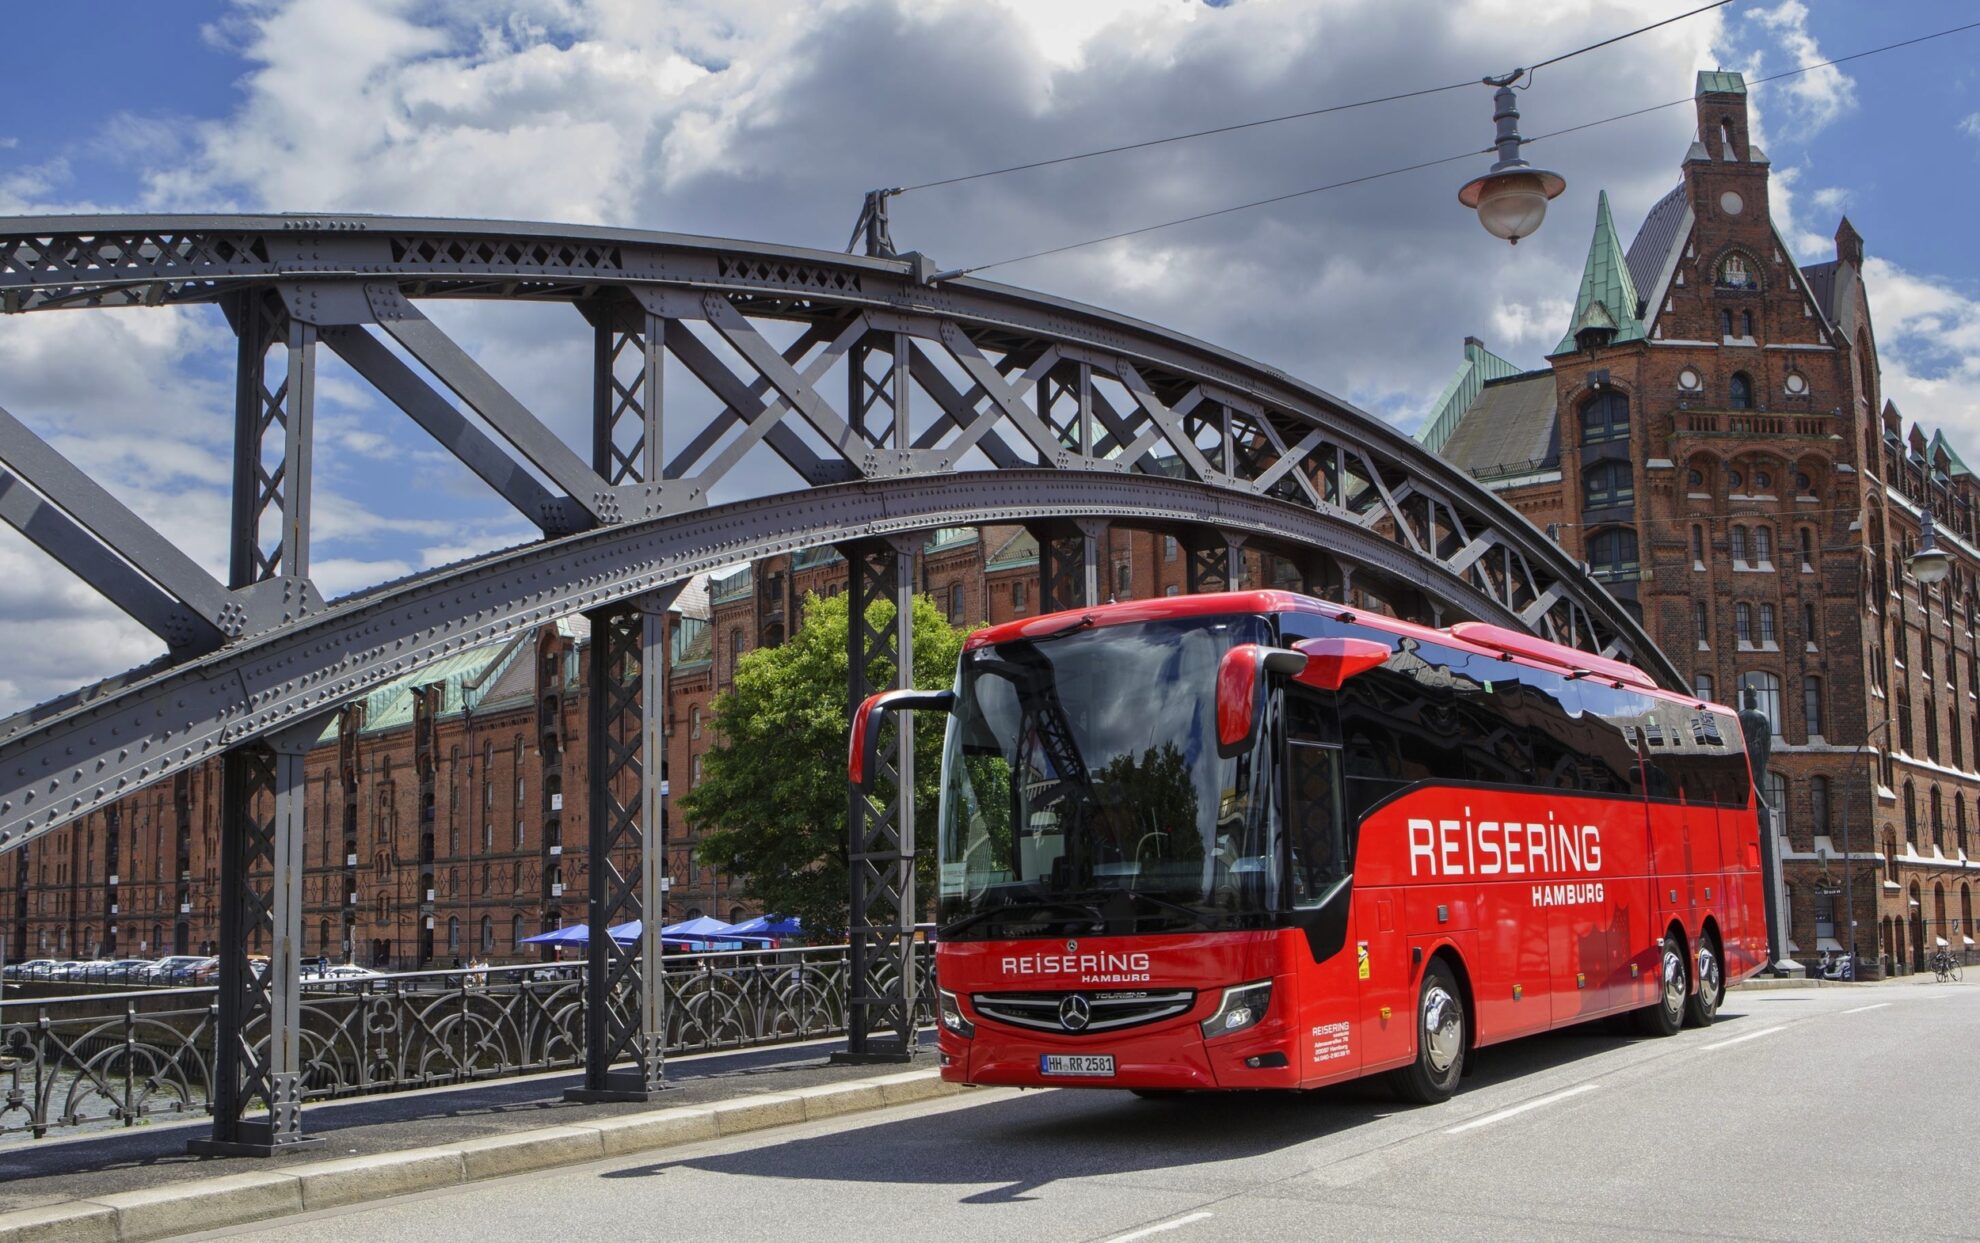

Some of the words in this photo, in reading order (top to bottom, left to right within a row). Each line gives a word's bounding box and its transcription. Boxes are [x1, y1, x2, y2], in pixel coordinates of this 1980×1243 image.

[1532, 883, 1604, 907] HAMBURG
[1082, 973, 1150, 983] HAMBURG
[1048, 1057, 1062, 1071] HH
[1069, 1057, 1083, 1071] RR
[1085, 1057, 1113, 1072] 2581
